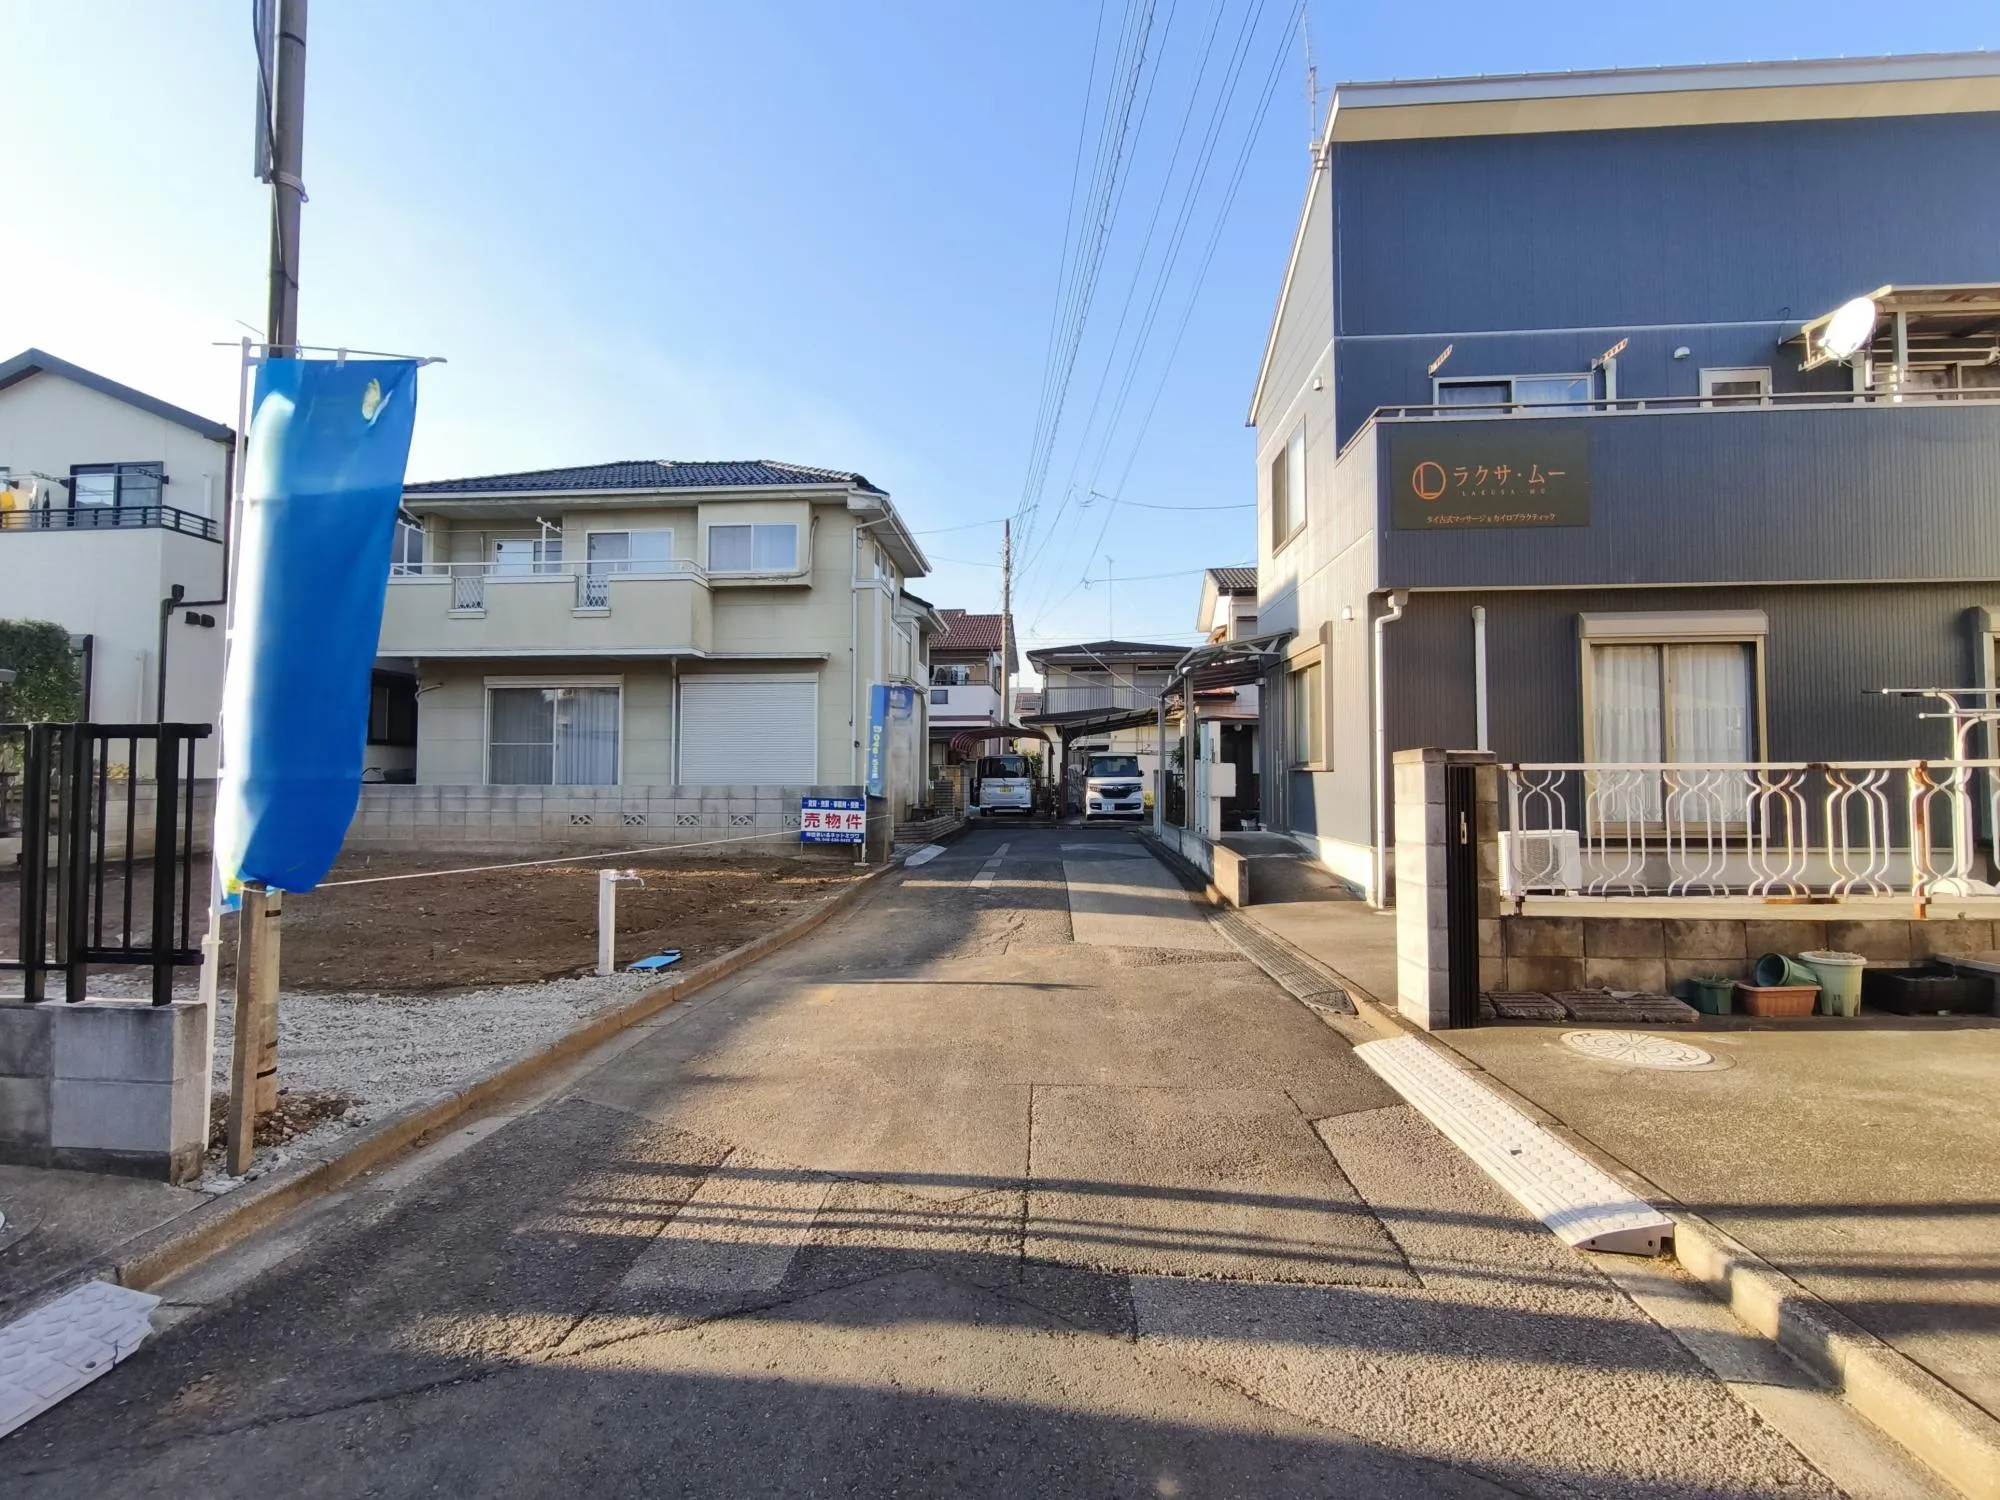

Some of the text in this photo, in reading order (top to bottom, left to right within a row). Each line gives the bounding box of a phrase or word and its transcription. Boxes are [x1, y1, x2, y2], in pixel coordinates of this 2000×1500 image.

[1453, 464, 1566, 487] ラクサ・ムー
[804, 812, 862, 830] 売物件
